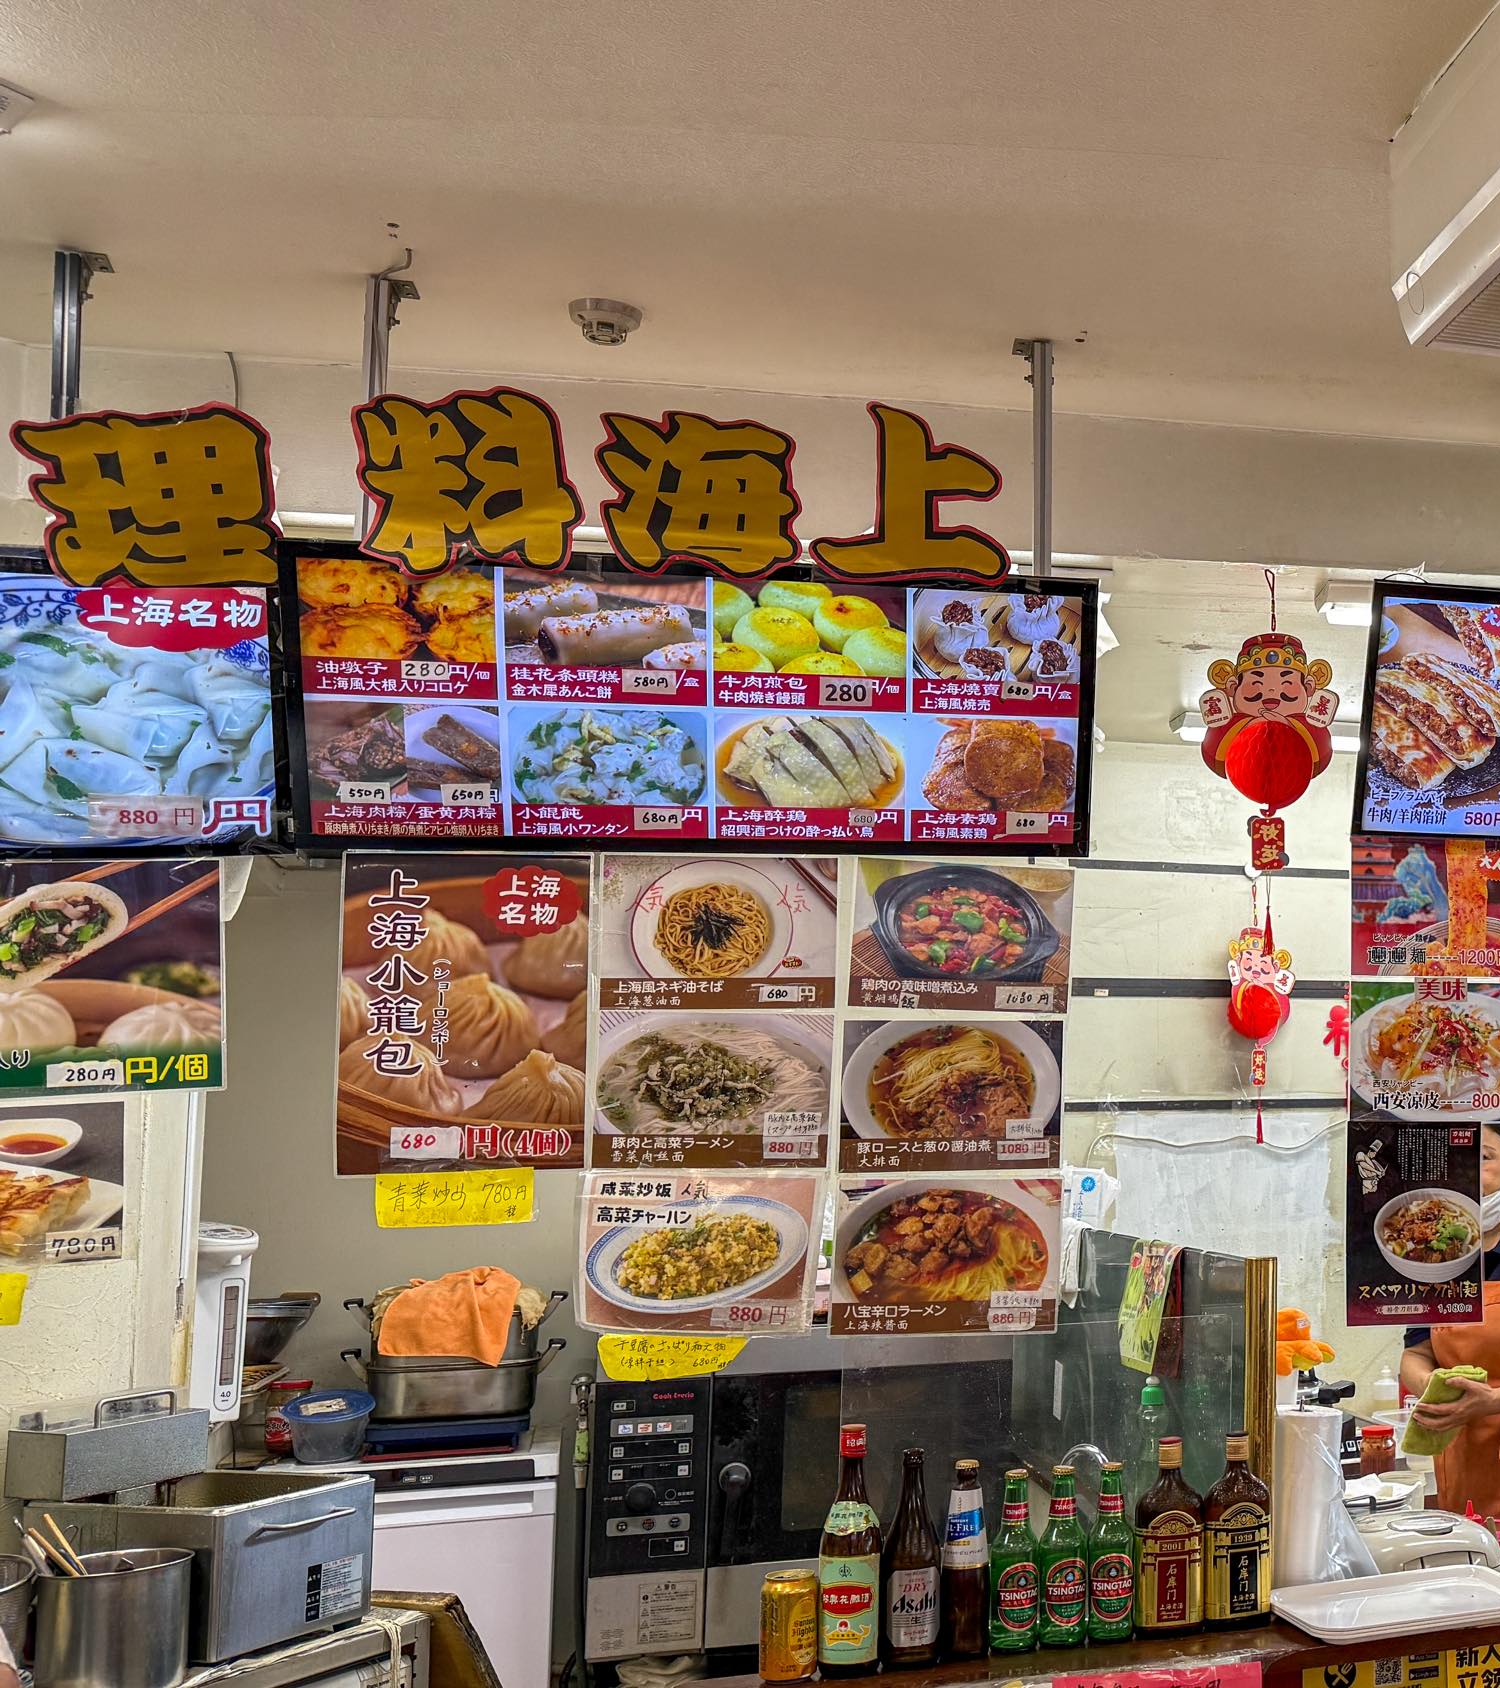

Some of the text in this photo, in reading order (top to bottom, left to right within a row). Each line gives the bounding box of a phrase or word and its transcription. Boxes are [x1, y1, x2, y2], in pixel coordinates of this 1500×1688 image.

[88, 595, 264, 629] 上海名物
[316, 660, 388, 676] 油墩子
[404, 662, 447, 678] 280
[633, 676, 668, 689] 580円
[718, 675, 868, 703] 牛肉煎包 280
[511, 683, 613, 700] 金木犀あんこ餅
[718, 690, 806, 707] 牛肉焼き饅頭
[1006, 687, 1030, 698] 680
[919, 699, 992, 713] 上海風焼売
[348, 788, 386, 801] 550円
[450, 788, 485, 801] 650円
[119, 807, 195, 828] 880 円
[641, 811, 679, 824] 680円
[852, 813, 874, 825] 680
[1015, 817, 1036, 828] 680
[1047, 815, 1068, 828] 円
[516, 822, 630, 836] 上海風小ワンタン
[917, 826, 988, 841] 上海風素鶏
[498, 873, 561, 898] 上海
[498, 902, 560, 926] 名物
[363, 867, 431, 1079] 上海小籠包
[613, 980, 725, 995] 上海風ネギ油そば
[766, 988, 789, 999] 680
[1418, 978, 1468, 1001] 美味
[65, 1066, 117, 1083] 280円
[125, 1053, 209, 1085] 円/個
[400, 1132, 437, 1150] 680
[611, 1136, 735, 1150] 豚肉と高菜ラーメン
[768, 1141, 794, 1154] 880
[596, 1205, 692, 1225] 高菜チャーハン
[51, 1235, 117, 1255] 780円
[728, 1304, 788, 1325] 880 円
[843, 1302, 948, 1318] 八宝辛口ラーメン
[992, 1311, 1031, 1325] 880 円
[1162, 1542, 1182, 1551] 2001
[1234, 1533, 1253, 1543] 1939
[903, 1582, 928, 1594] DRY
[1092, 1580, 1132, 1593] TSINGTAO
[893, 1589, 938, 1614] Asahi
